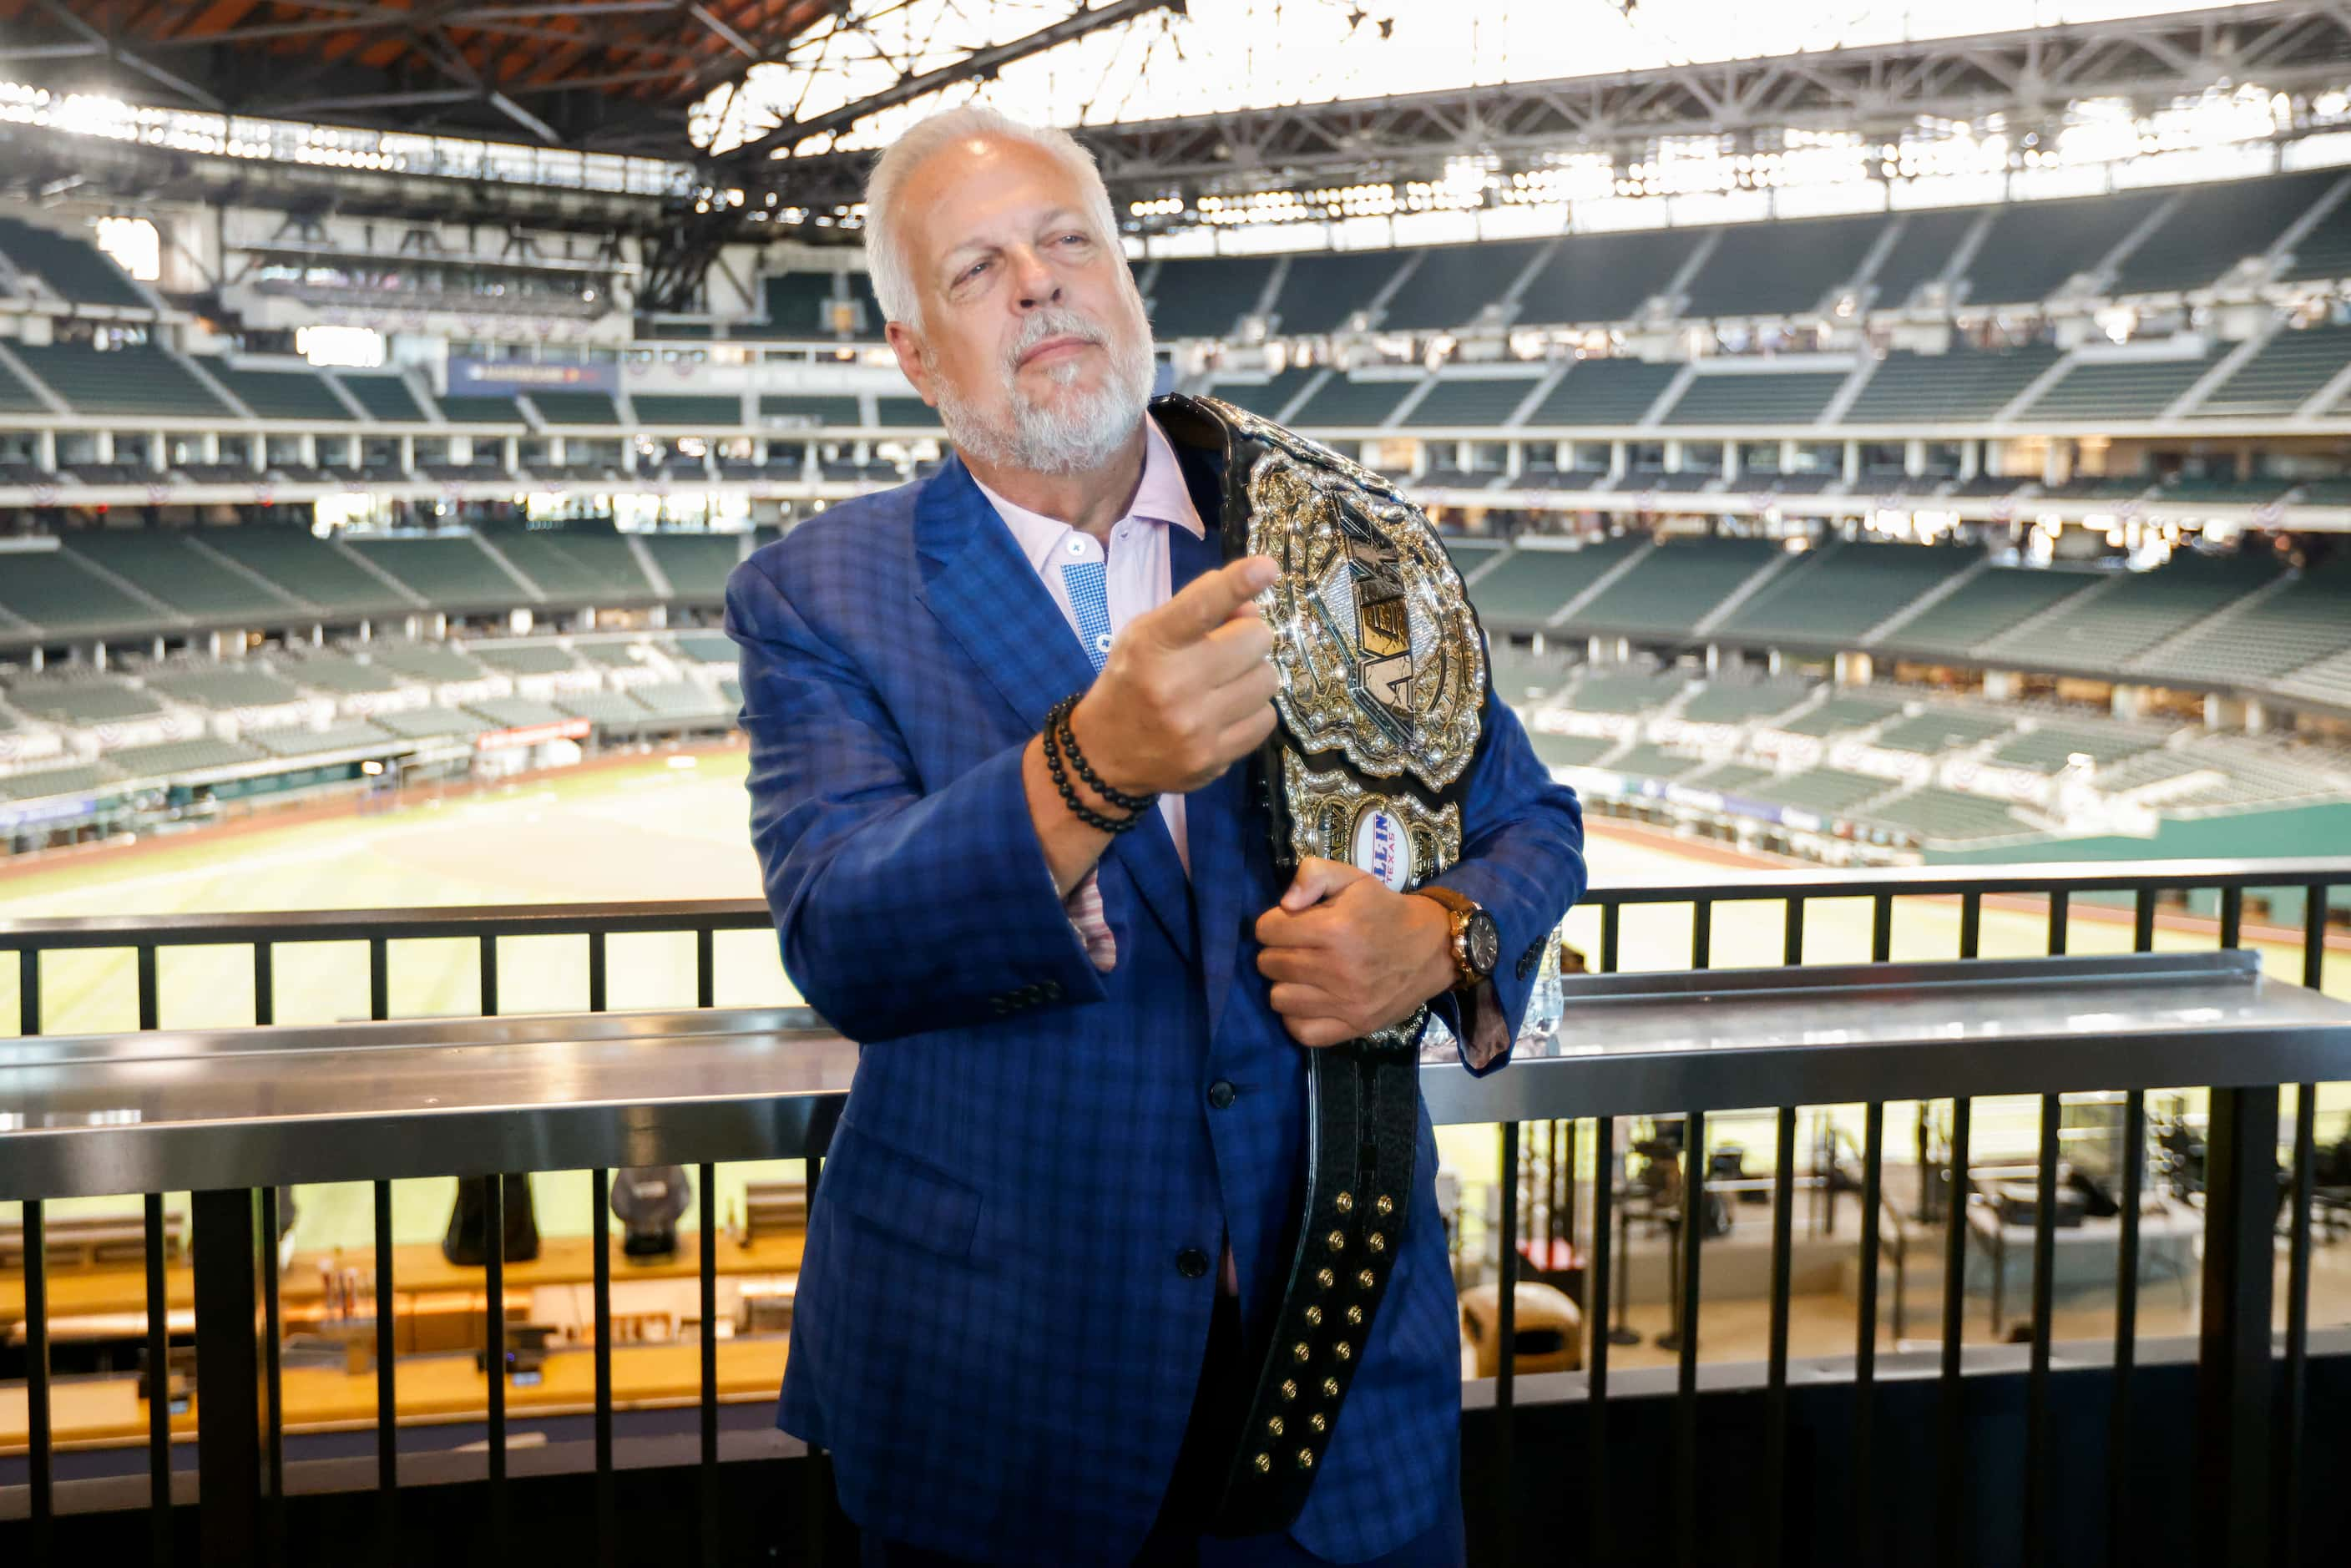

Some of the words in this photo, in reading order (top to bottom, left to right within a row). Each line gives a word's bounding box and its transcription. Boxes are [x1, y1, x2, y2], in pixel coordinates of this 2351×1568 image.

[1337, 493, 1413, 741] AEW
[1375, 813, 1388, 842] IN
[1373, 847, 1387, 881] LL
[1386, 832, 1395, 883] TEXAS
